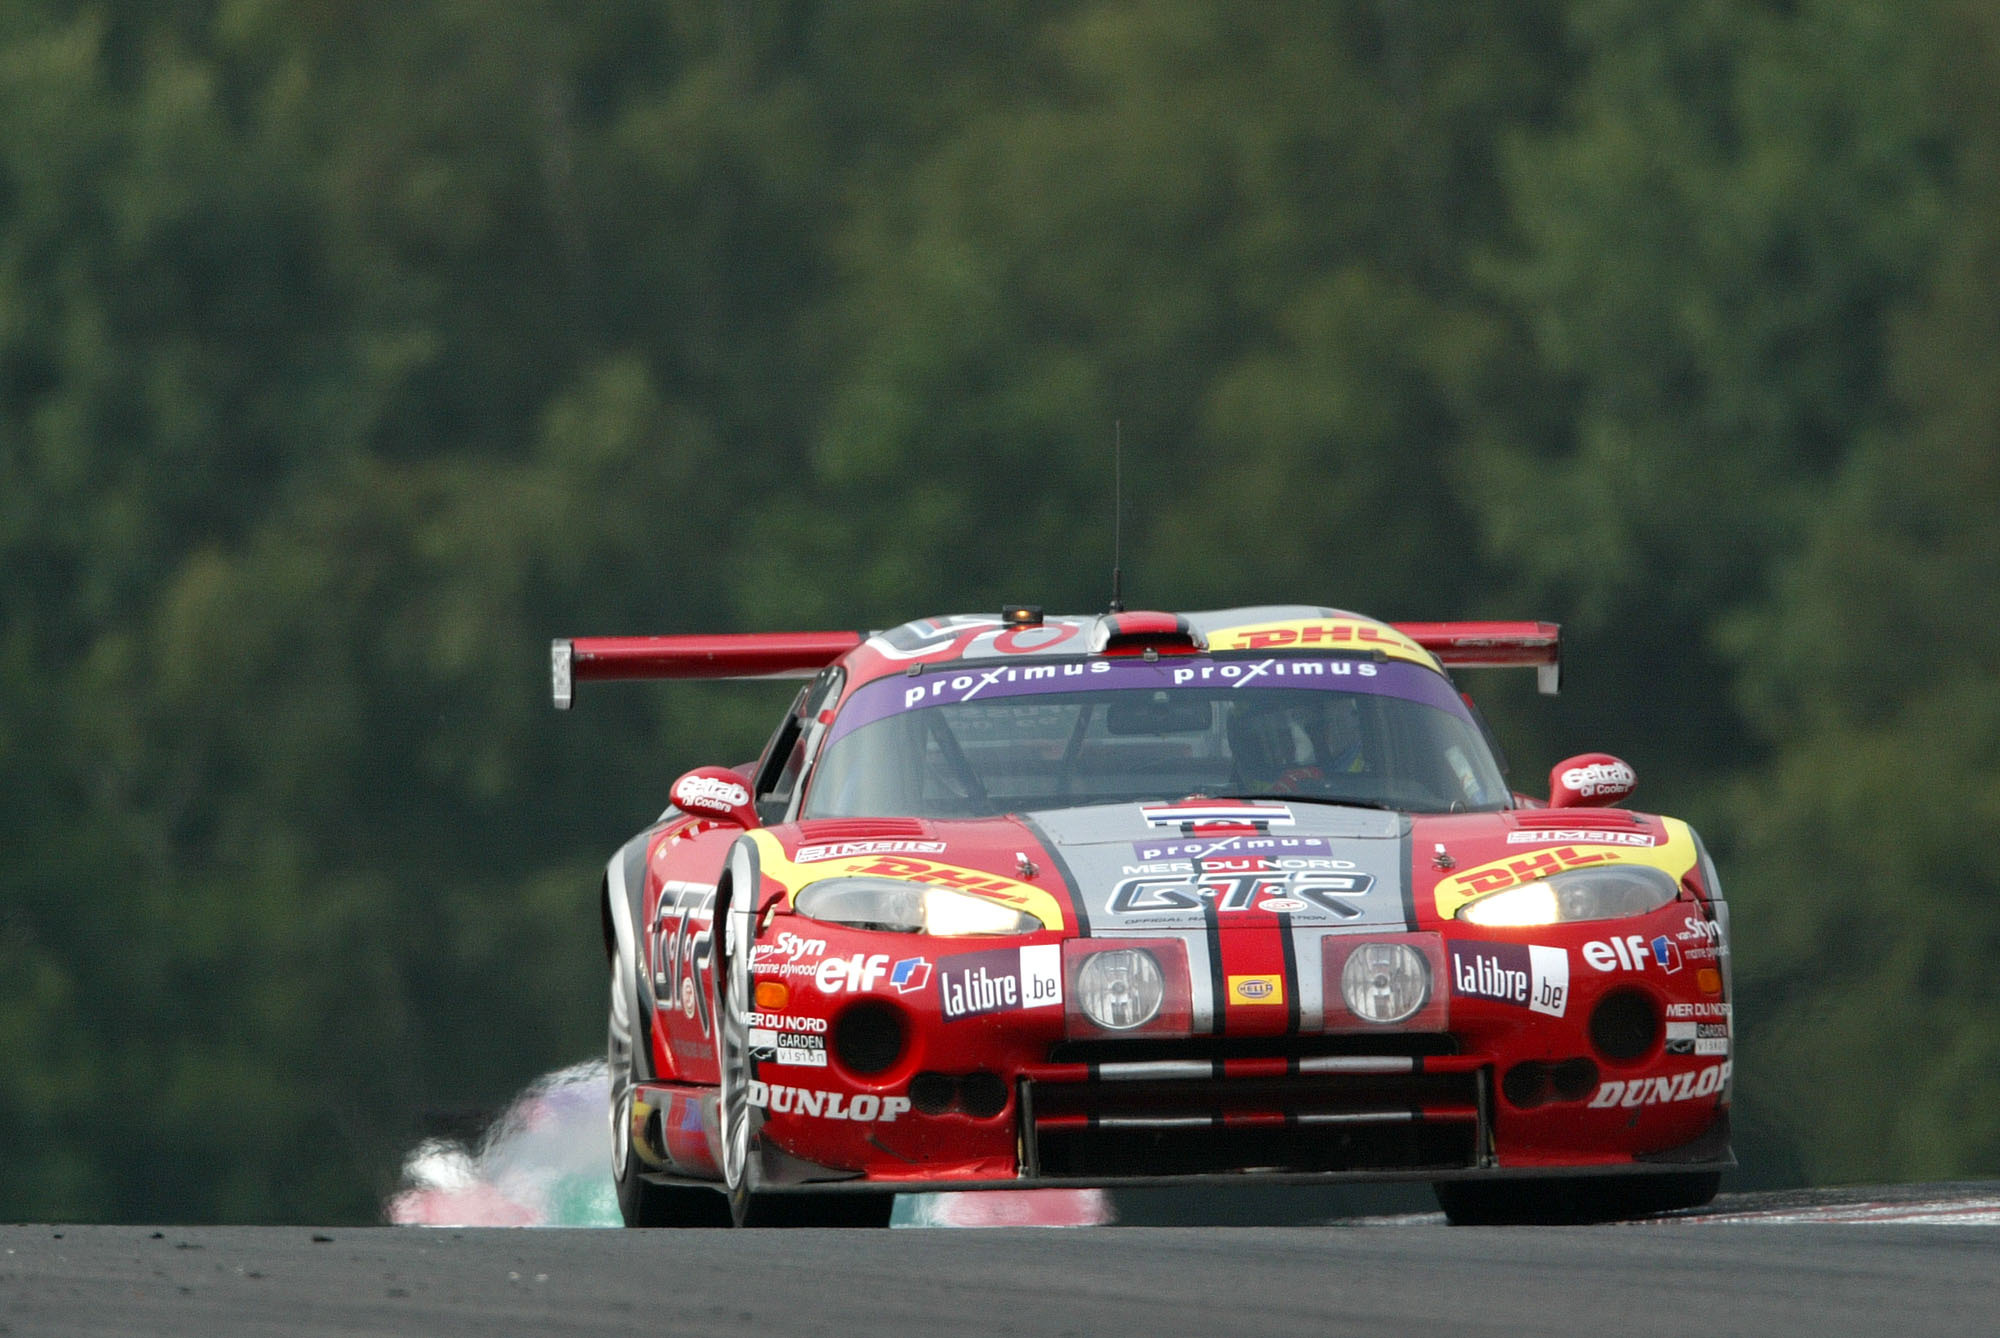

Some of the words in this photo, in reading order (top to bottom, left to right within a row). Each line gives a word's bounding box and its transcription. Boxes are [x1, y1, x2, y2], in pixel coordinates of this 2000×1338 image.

[1237, 626, 1403, 649] DHL
[905, 661, 1111, 707] proximus
[1174, 659, 1378, 688] proximus
[1143, 836, 1322, 859] proximus
[862, 857, 1018, 902] DHL
[1122, 864, 1195, 875] MER
[1200, 860, 1243, 870] DU
[1257, 859, 1356, 870] NORD
[1455, 847, 1605, 894] DHL
[1685, 918, 1721, 943] Styn
[774, 932, 826, 961] Styn
[1582, 935, 1649, 972] elf
[779, 961, 819, 978] plywood
[816, 954, 889, 993] elf
[740, 1012, 764, 1026] MER
[765, 1014, 784, 1029] DU
[786, 1016, 827, 1032] NORD
[1667, 1003, 1693, 1017] MER
[1695, 1003, 1710, 1016] DU
[779, 1034, 823, 1049] GARDEN
[1587, 1060, 1733, 1108] DUNLOP
[747, 1080, 911, 1121] DUNLOP
